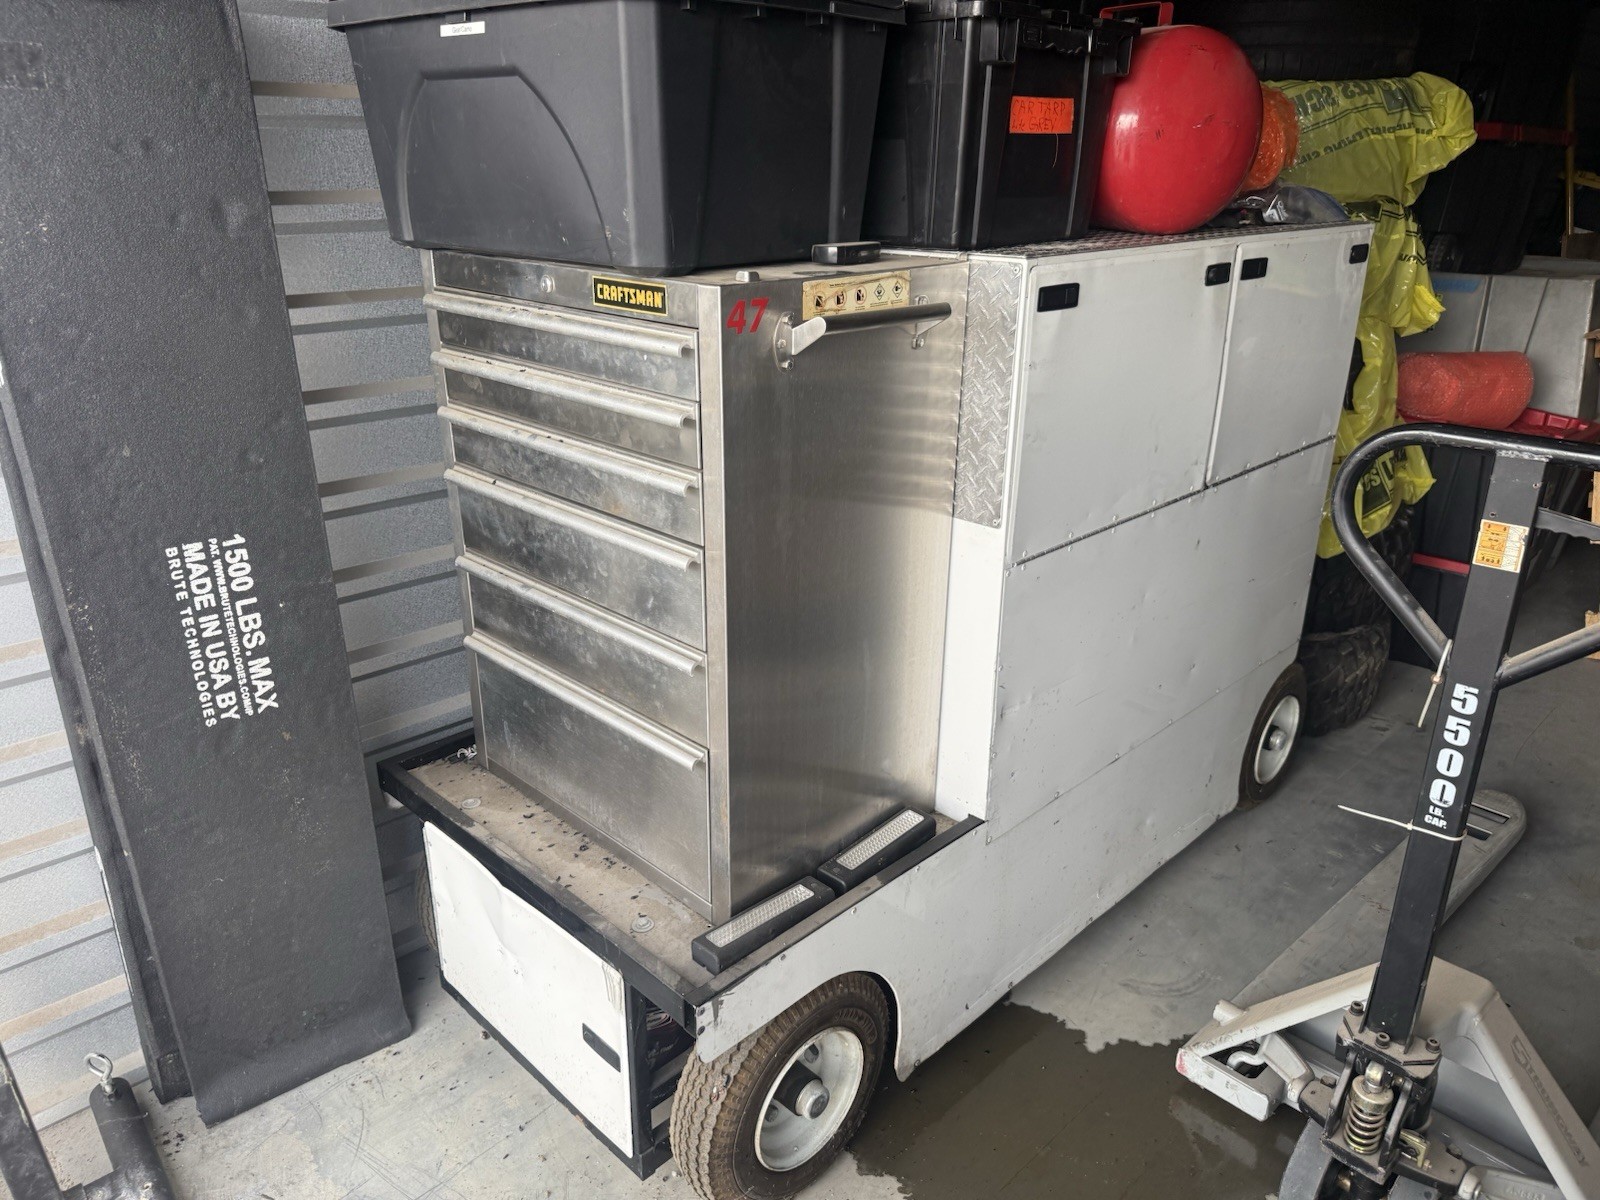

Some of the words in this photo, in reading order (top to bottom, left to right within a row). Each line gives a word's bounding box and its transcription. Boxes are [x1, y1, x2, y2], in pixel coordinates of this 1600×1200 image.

[1012, 99, 1035, 115] CAR
[1038, 101, 1066, 117] TARP
[1029, 116, 1057, 132] GREY
[597, 283, 663, 308] CRAFTSMAN
[727, 297, 768, 334] 47
[208, 538, 221, 558] PAT.
[222, 533, 254, 592] 1500
[182, 542, 216, 611] MADE
[165, 547, 188, 602] BRUTE
[180, 606, 217, 728] TECHNOLOGIES
[198, 614, 222, 639] IN
[235, 597, 266, 657] LBS.
[205, 641, 232, 691] USA
[248, 656, 278, 715] MAX
[215, 691, 240, 720] BY
[1429, 683, 1479, 808] 5500
[1424, 814, 1447, 829] CAP.
[1428, 805, 1445, 818] LB.
